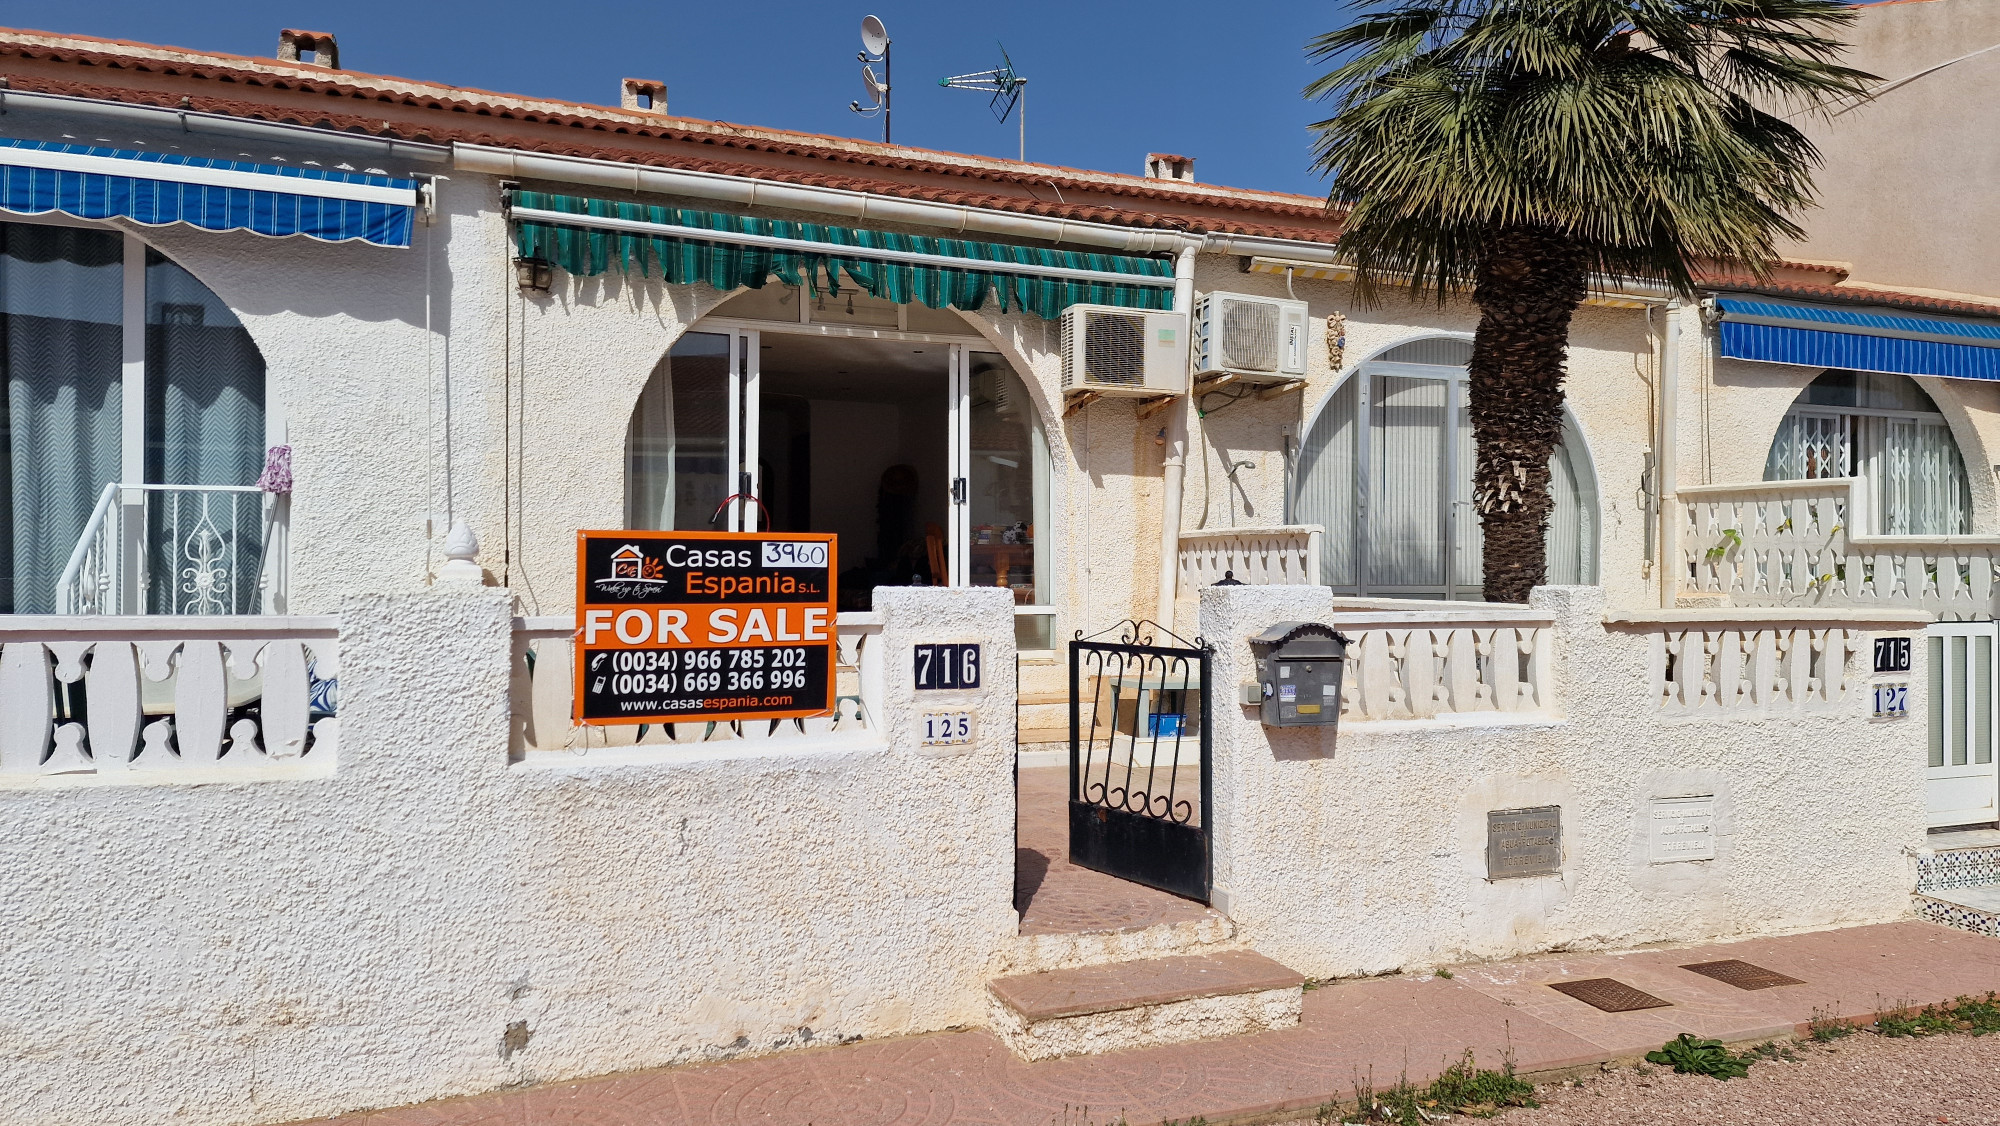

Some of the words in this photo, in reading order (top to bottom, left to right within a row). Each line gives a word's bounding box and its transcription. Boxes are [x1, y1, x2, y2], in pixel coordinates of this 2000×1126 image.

[666, 544, 752, 568] Casas
[766, 542, 825, 565] 3960
[686, 571, 796, 599] Espania
[798, 583, 820, 593] S.L.
[584, 608, 692, 645] FOR
[708, 607, 828, 643] SALE
[612, 650, 678, 672] (0034)
[684, 650, 722, 670] 966
[728, 649, 764, 669] 785
[771, 648, 806, 668] 202
[918, 648, 976, 685] 716
[1876, 640, 1909, 668] 715
[611, 673, 677, 695] (0034)
[683, 672, 721, 692] 669
[727, 670, 764, 690] 366
[770, 669, 806, 689] 996
[620, 695, 793, 711] www.casasespania.com
[1874, 687, 1908, 712] 127
[926, 717, 968, 738] 125
